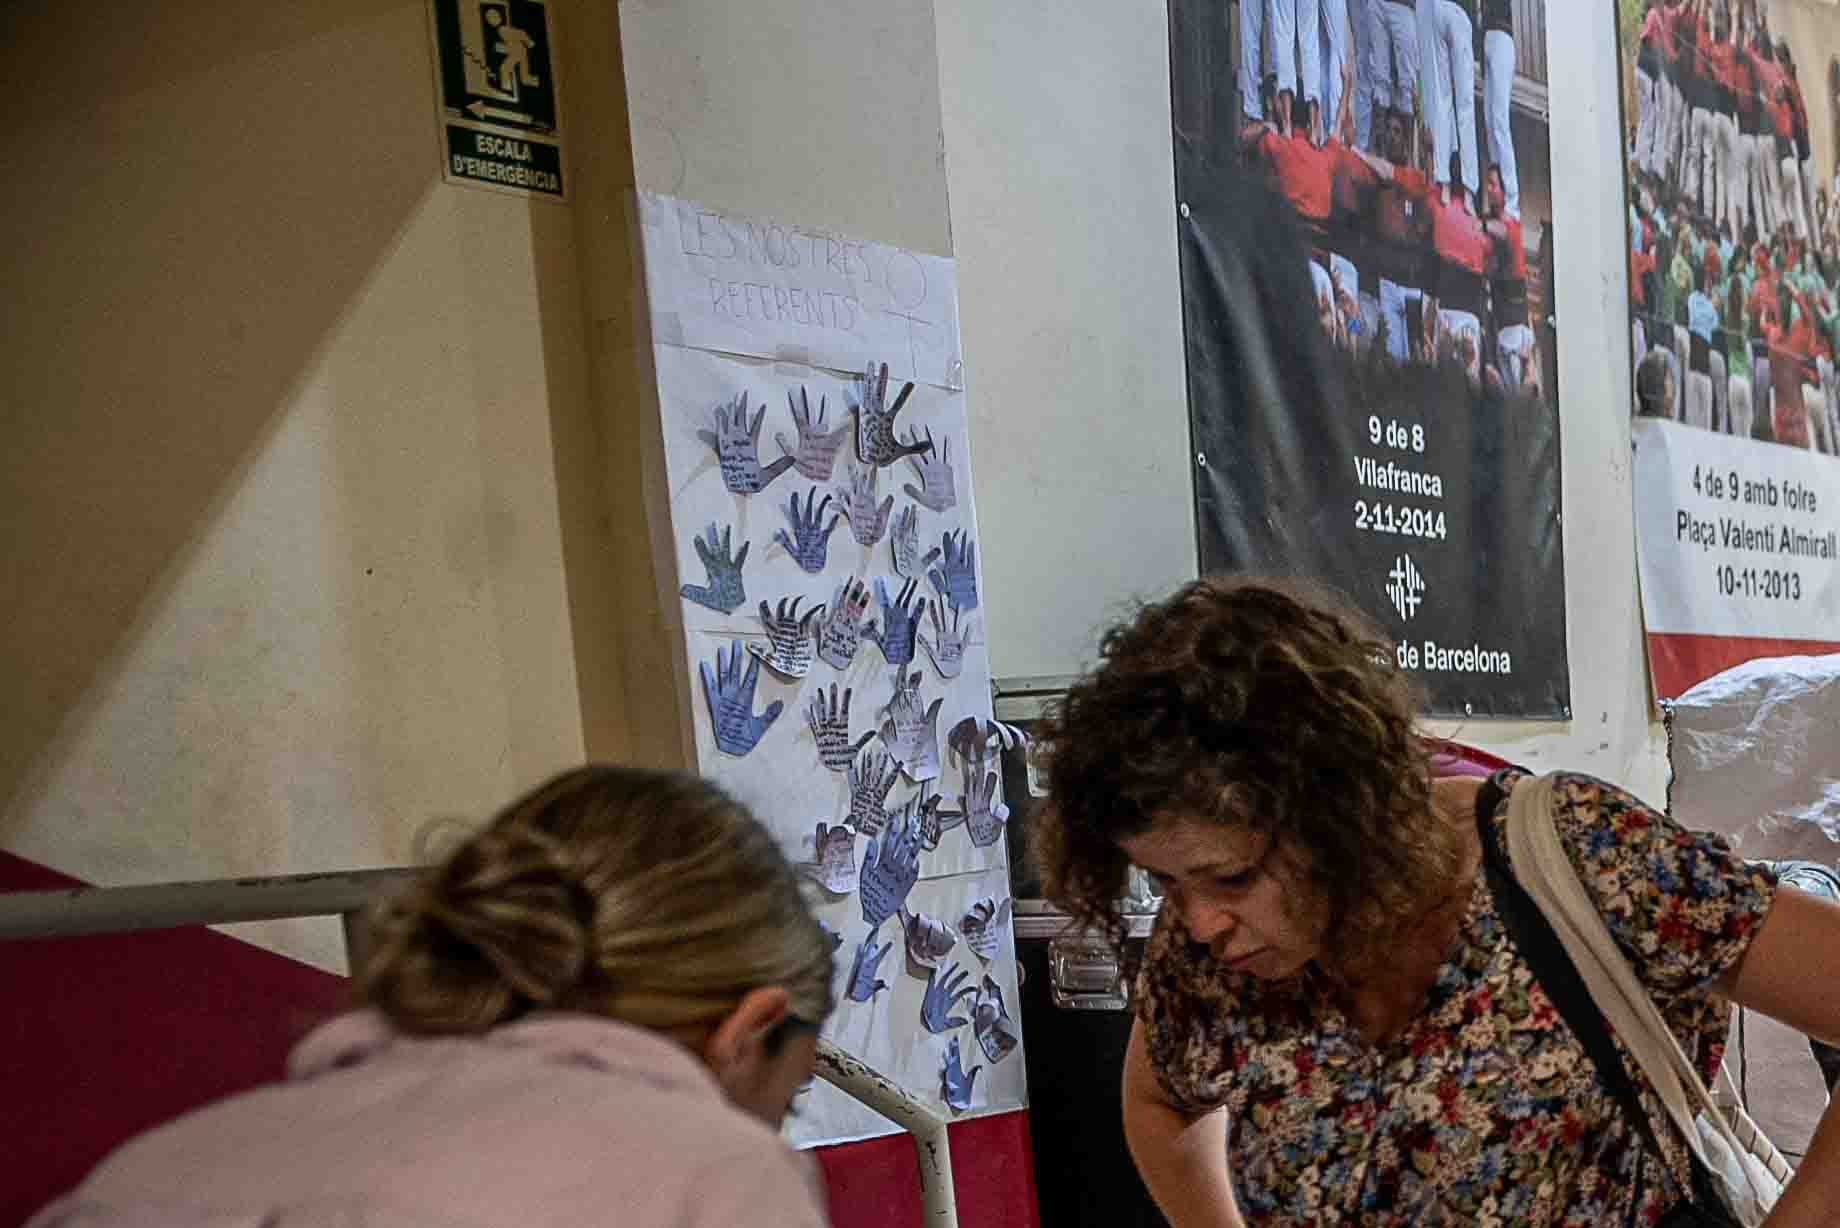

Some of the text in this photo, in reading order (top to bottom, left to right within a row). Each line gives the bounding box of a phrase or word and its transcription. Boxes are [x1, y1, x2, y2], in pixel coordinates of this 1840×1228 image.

[476, 134, 532, 161] ESCALA
[1368, 415, 1425, 452] 9 de 8
[1354, 456, 1443, 497] Vilafranca
[1693, 464, 1817, 513] 4 de 9 amb folre
[1354, 500, 1447, 539] 2-11-2014
[1677, 509, 1716, 552] Plaça
[1779, 525, 1837, 560] Almirall
[1717, 564, 1801, 601] 10-11-2013
[1396, 640, 1512, 674] de Barcelona
